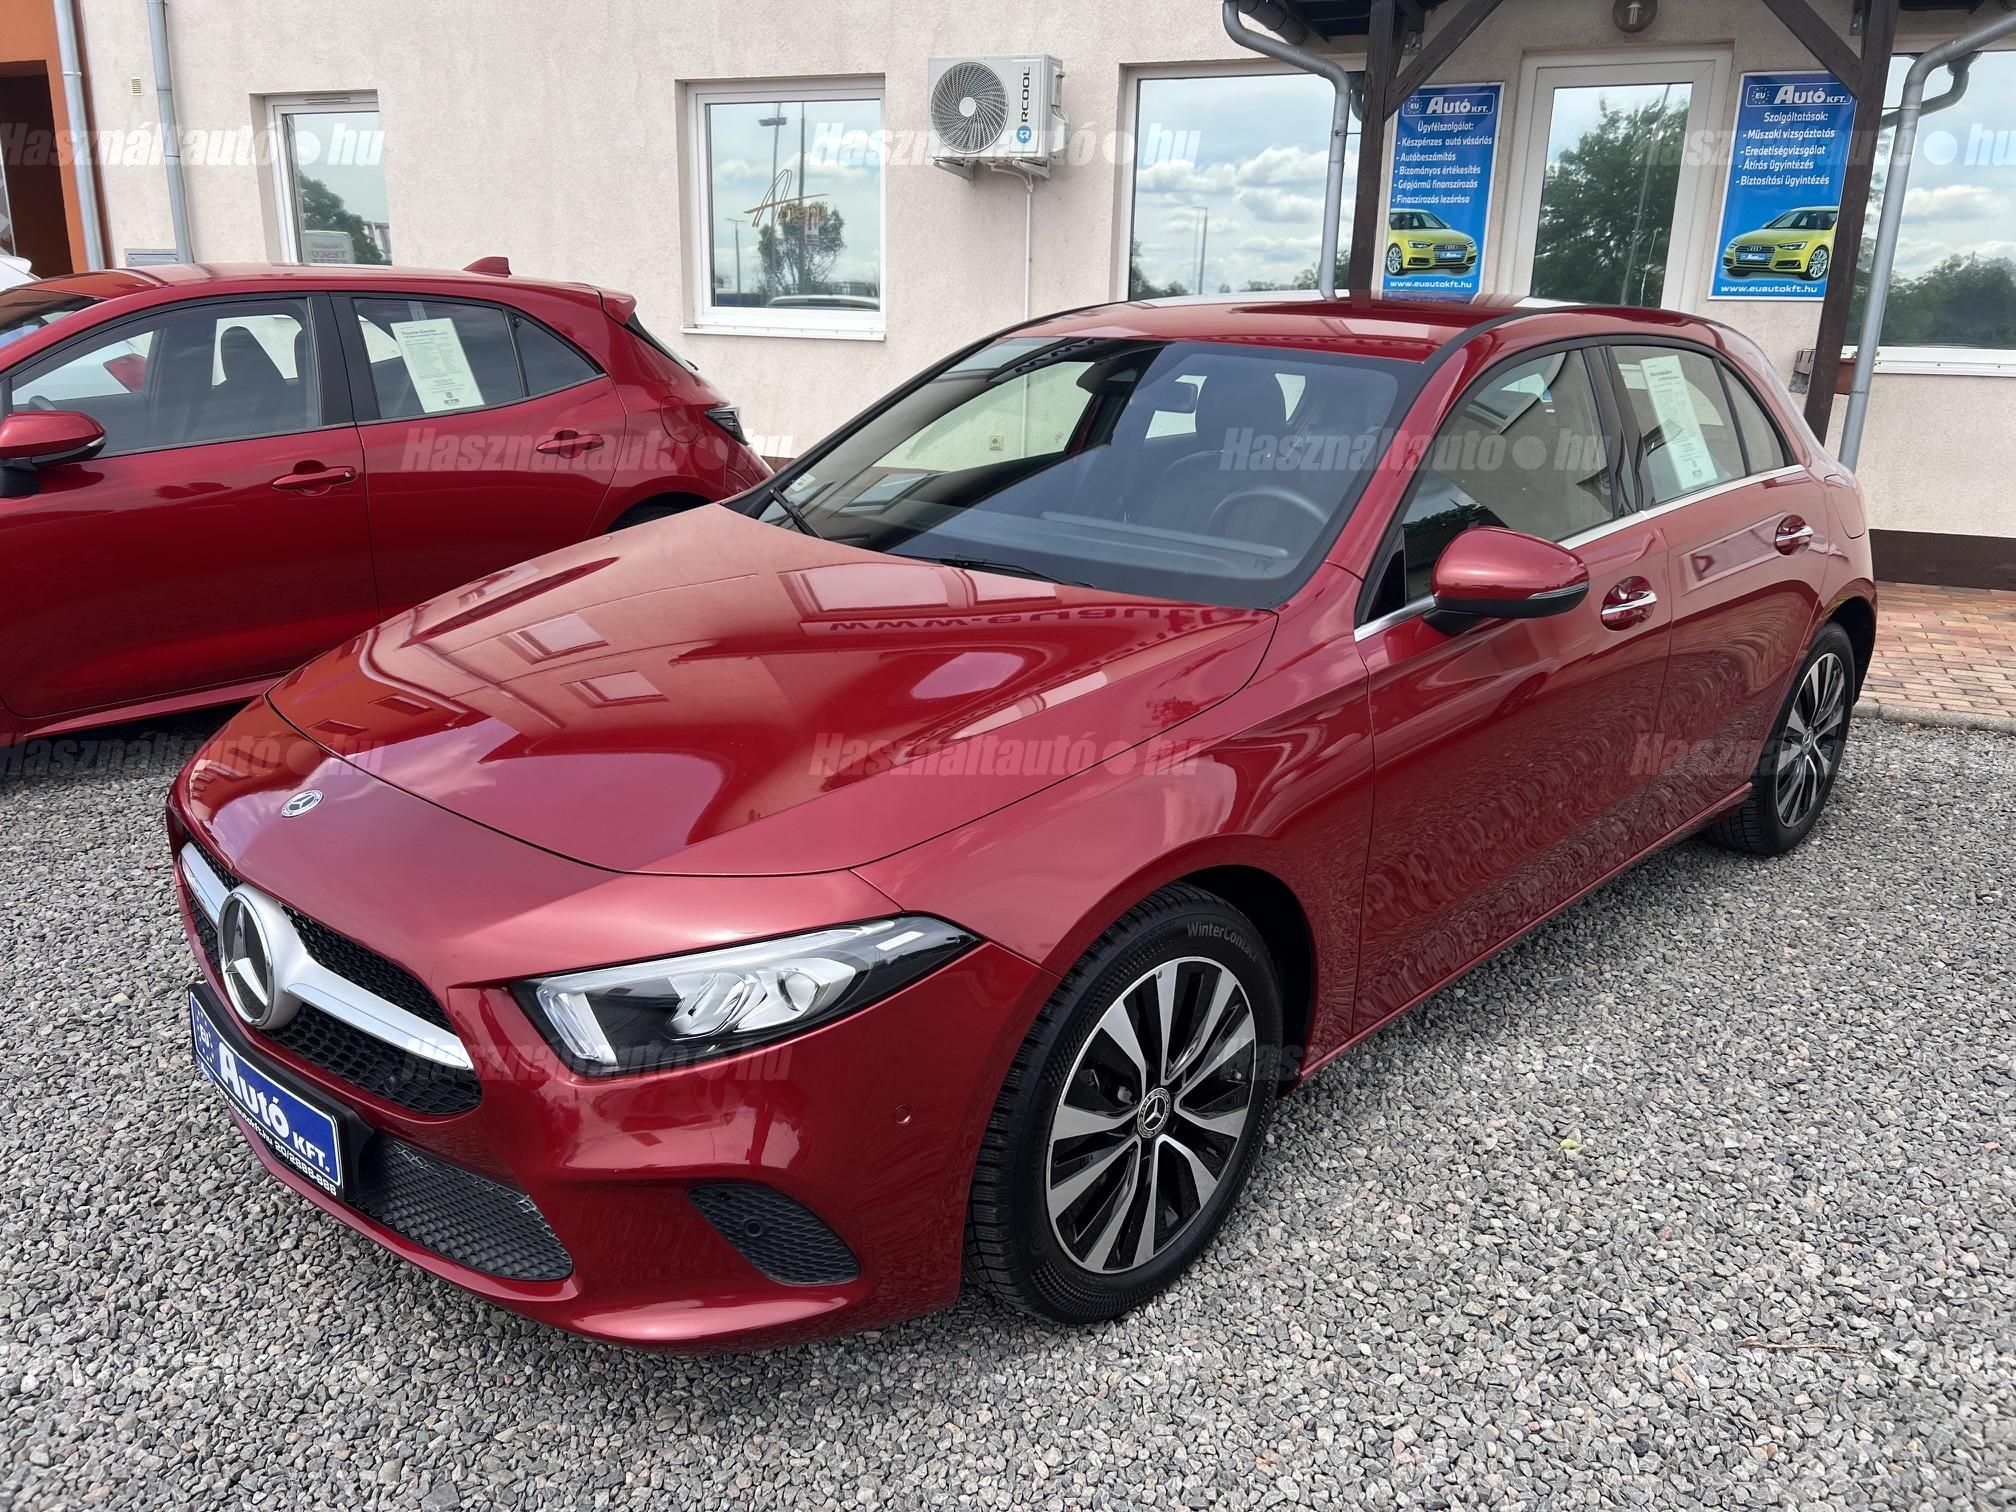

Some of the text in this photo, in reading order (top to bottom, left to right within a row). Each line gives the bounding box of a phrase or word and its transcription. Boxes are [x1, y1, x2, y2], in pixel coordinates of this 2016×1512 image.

[1020, 67, 1031, 123] RCOOL
[1774, 85, 1826, 104] Autó
[1426, 97, 1471, 114] Autó
[1471, 105, 1489, 113] KFT.
[1763, 111, 1829, 124] Szolgáltatások:
[1417, 120, 1475, 133] Ügyfélszolgálat:
[1747, 127, 1836, 140] Műszaki vizsgáztatás
[1401, 136, 1493, 148] Készpénzes autó vásárlás
[1400, 152, 1457, 162] Autóbeszámítás
[1745, 145, 1826, 157] Eredetiségvizsgálat
[1399, 164, 1481, 176] Bizományos értékesítés
[1769, 161, 1814, 171] ügyintézés
[1785, 176, 1830, 187] ügyintézés
[1389, 280, 1473, 288] www.euautokft.hu
[1720, 284, 1818, 294] www.euautokft.hu
[218, 1041, 290, 1139] Autó
[292, 1131, 331, 1173] KFT.
